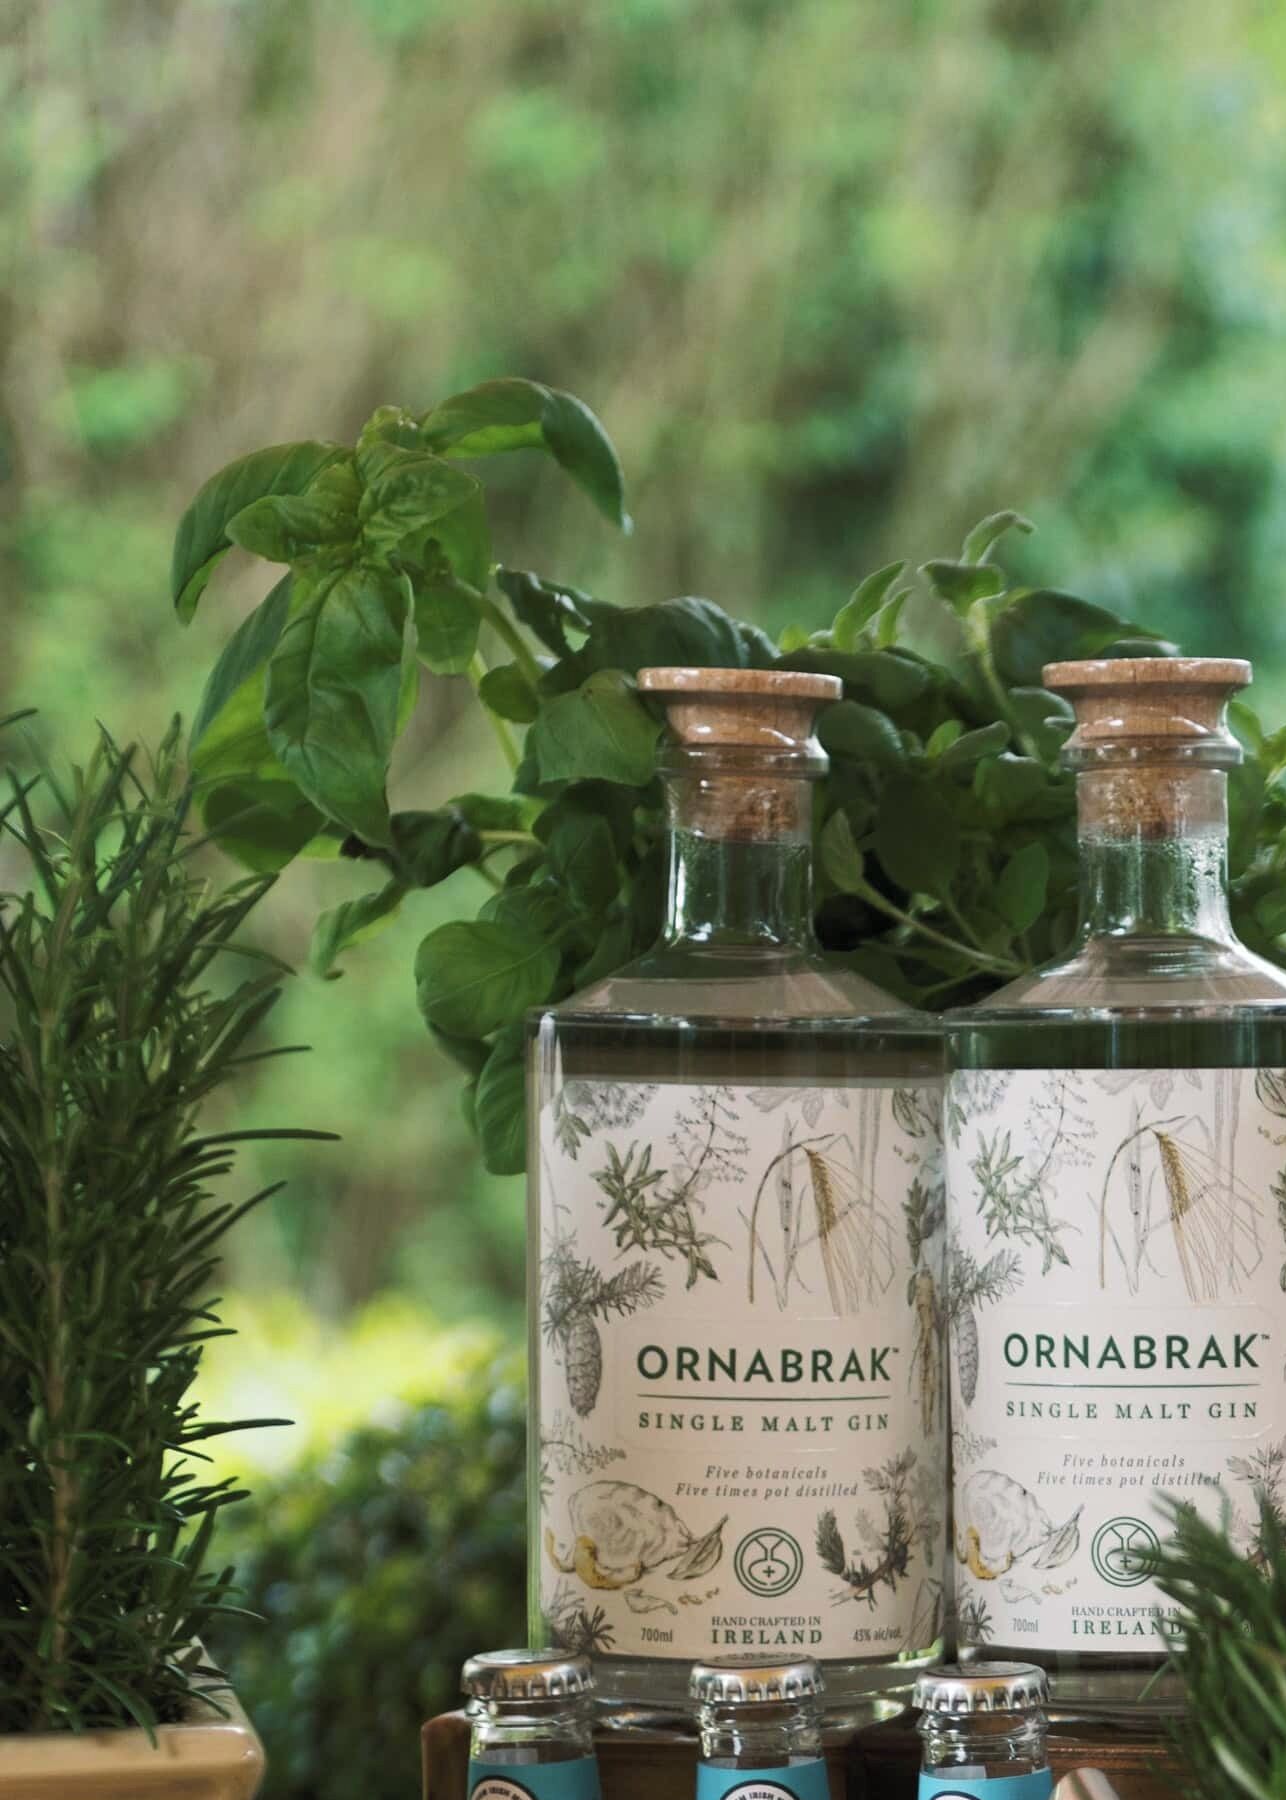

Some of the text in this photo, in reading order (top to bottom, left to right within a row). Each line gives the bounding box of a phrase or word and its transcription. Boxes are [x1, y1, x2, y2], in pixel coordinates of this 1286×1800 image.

[1005, 1400, 1258, 1420] SINGLE MALT GIN
[639, 1412, 889, 1432] SINGLE MALT GIN
[1063, 1453, 1186, 1468] Five botanicals
[705, 1465, 828, 1480] Five botanicals
[1037, 1471, 1222, 1488] Five times pot distilled
[675, 1482, 858, 1500] Five times pot distilled
[1072, 1606, 1104, 1617] HAND
[1107, 1606, 1164, 1618] CRAFTED
[711, 1616, 821, 1627] HAND CRAFTED IN
[1012, 1617, 1039, 1634] 700ml
[1072, 1619, 1183, 1636] IRELAND
[641, 1627, 674, 1643] 700ml
[711, 1629, 822, 1645] IRELAND
